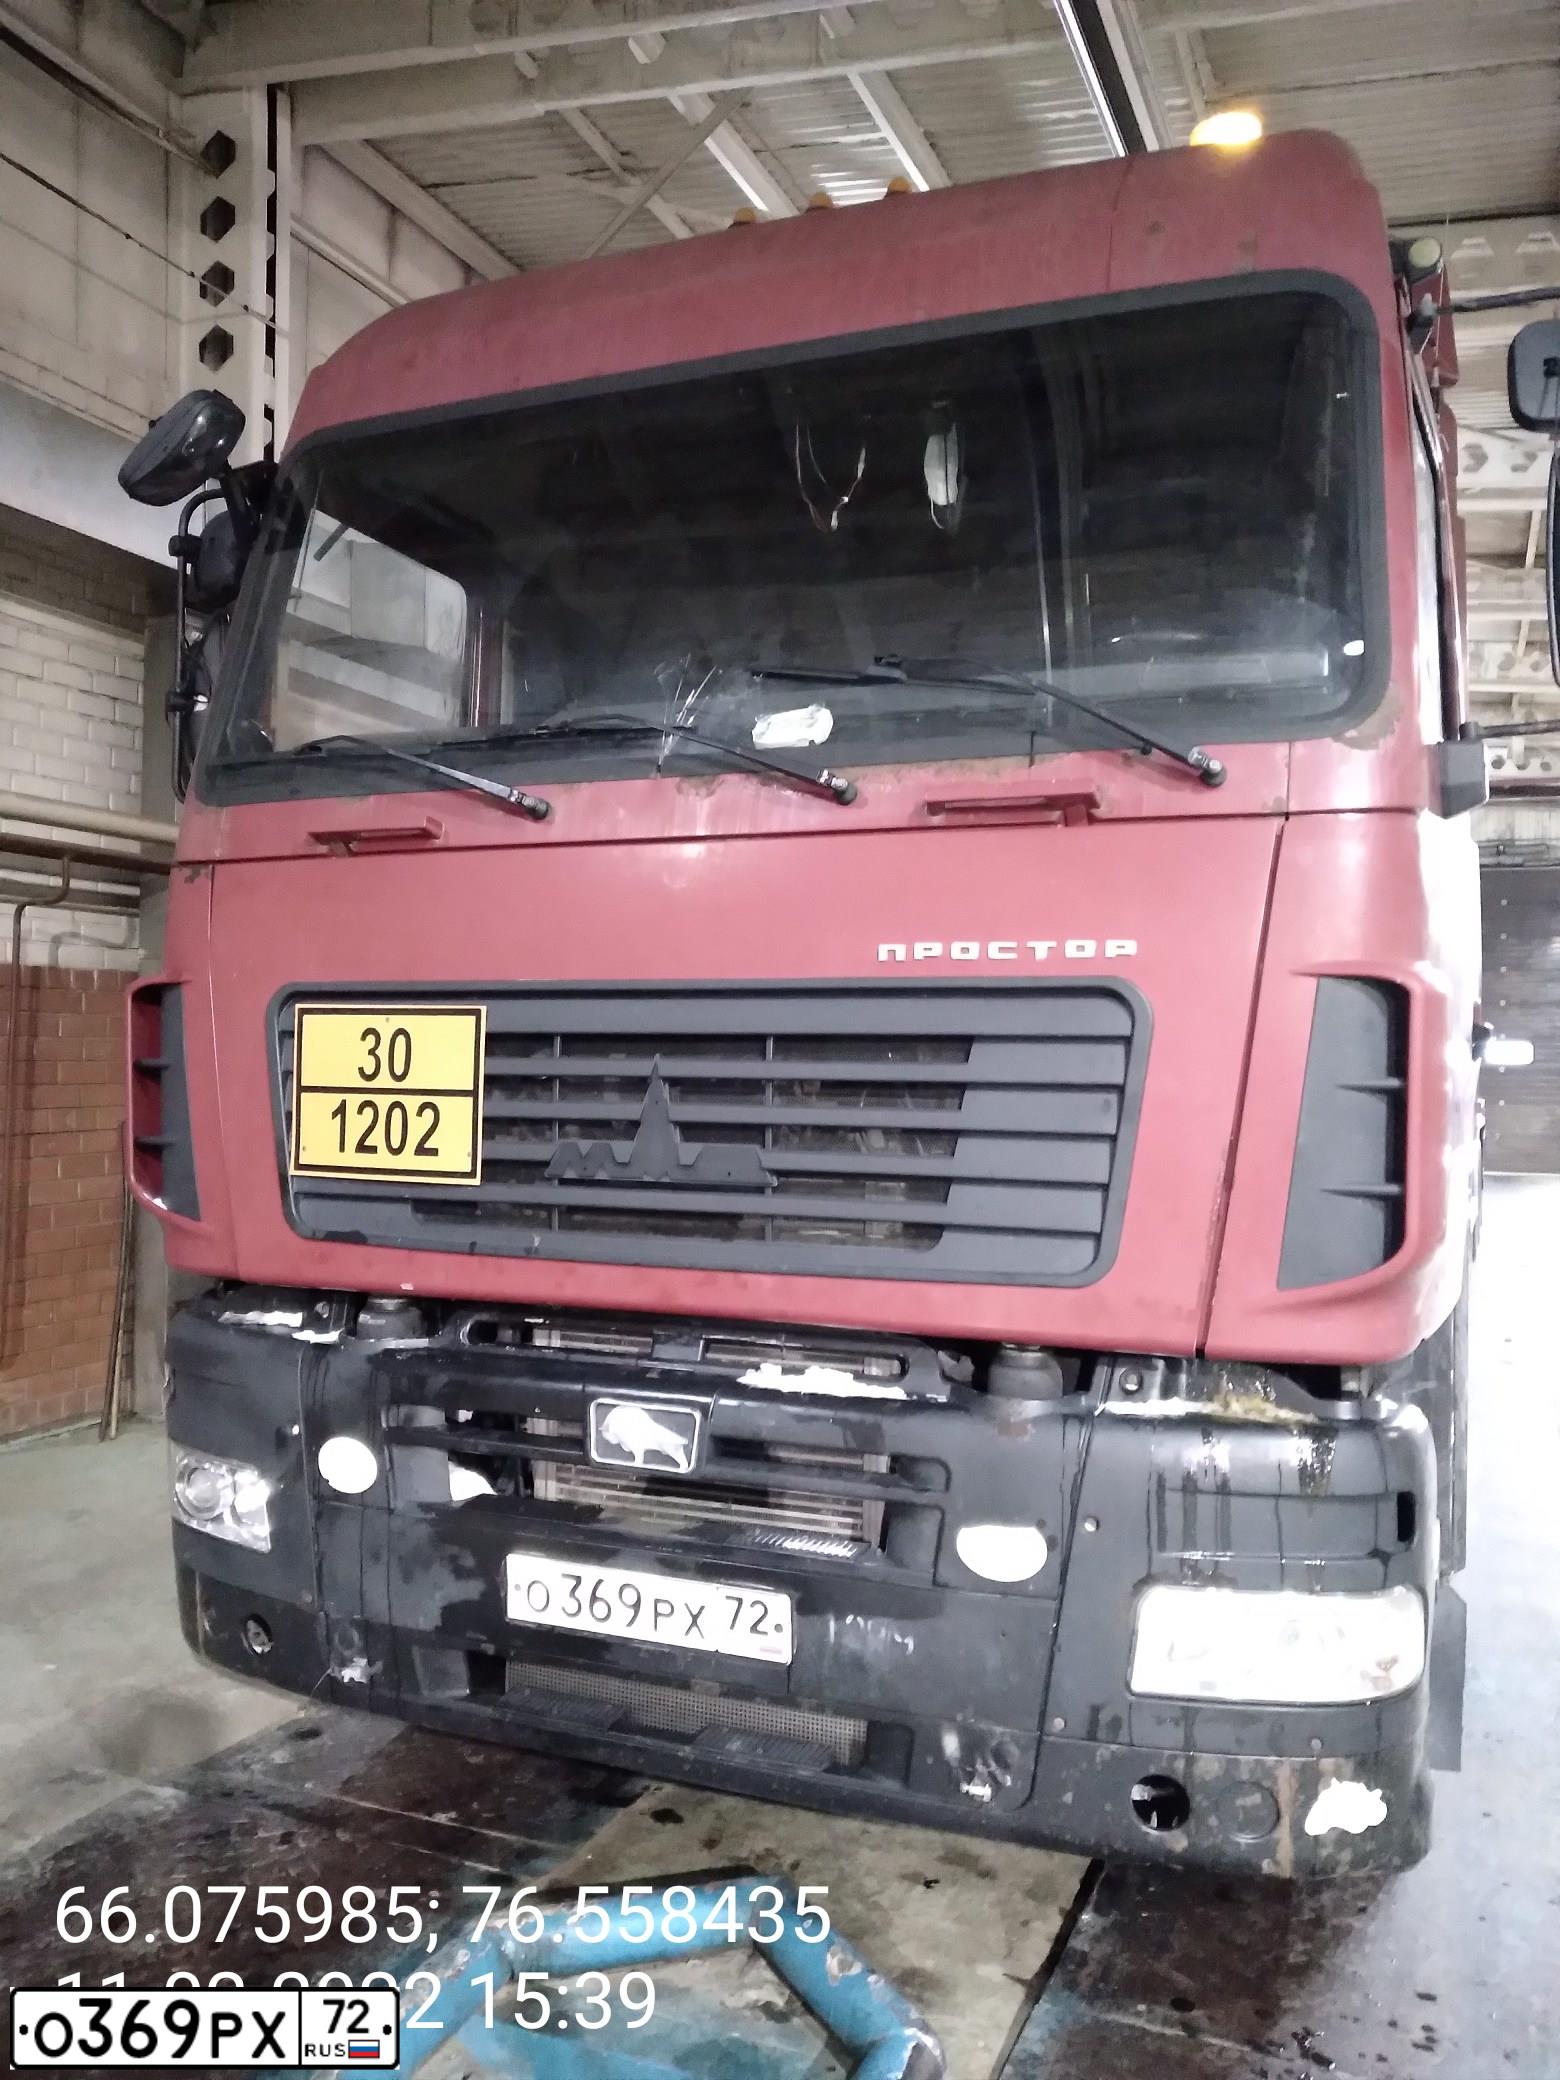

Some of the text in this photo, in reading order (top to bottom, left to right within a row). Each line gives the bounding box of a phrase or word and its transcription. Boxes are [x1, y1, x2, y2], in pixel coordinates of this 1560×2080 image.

[877, 938, 1139, 962] ПРОСТОР
[357, 1026, 413, 1083] 30
[331, 1098, 441, 1157] 1202
[724, 1594, 770, 1637] 72
